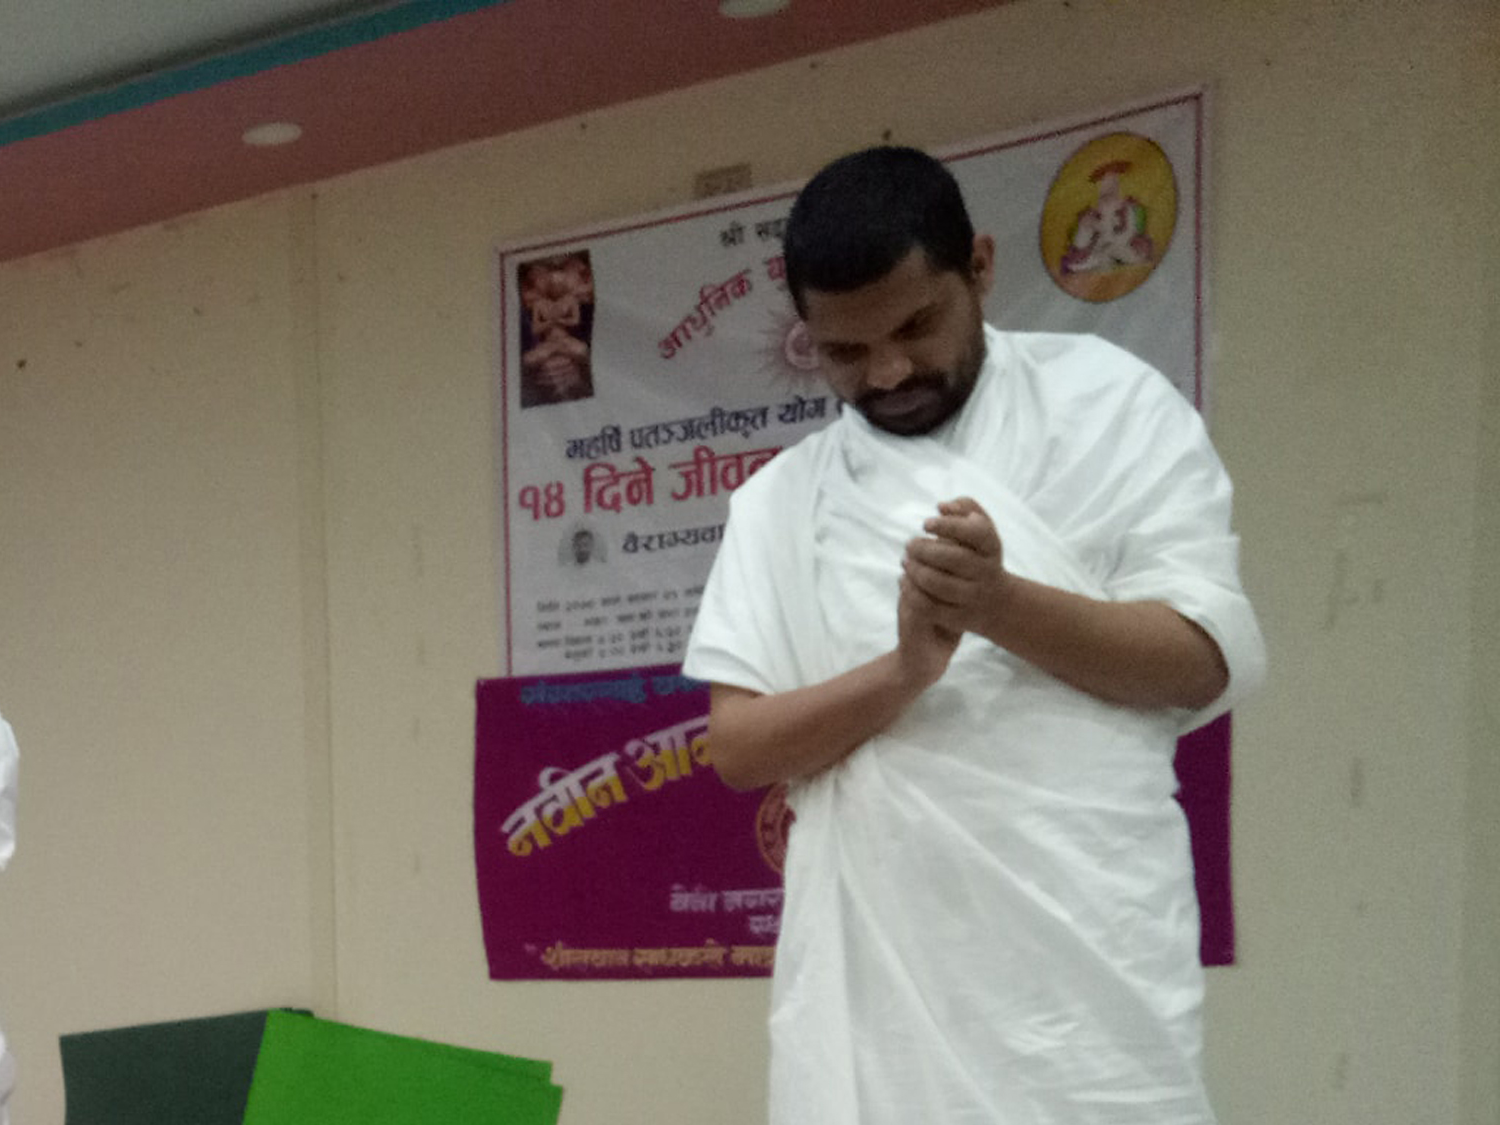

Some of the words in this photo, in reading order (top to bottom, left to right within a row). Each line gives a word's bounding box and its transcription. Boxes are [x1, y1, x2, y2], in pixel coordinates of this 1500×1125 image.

[518, 481, 565, 521] १४
[583, 456, 655, 514] दिने
[501, 752, 628, 857] नवीन
